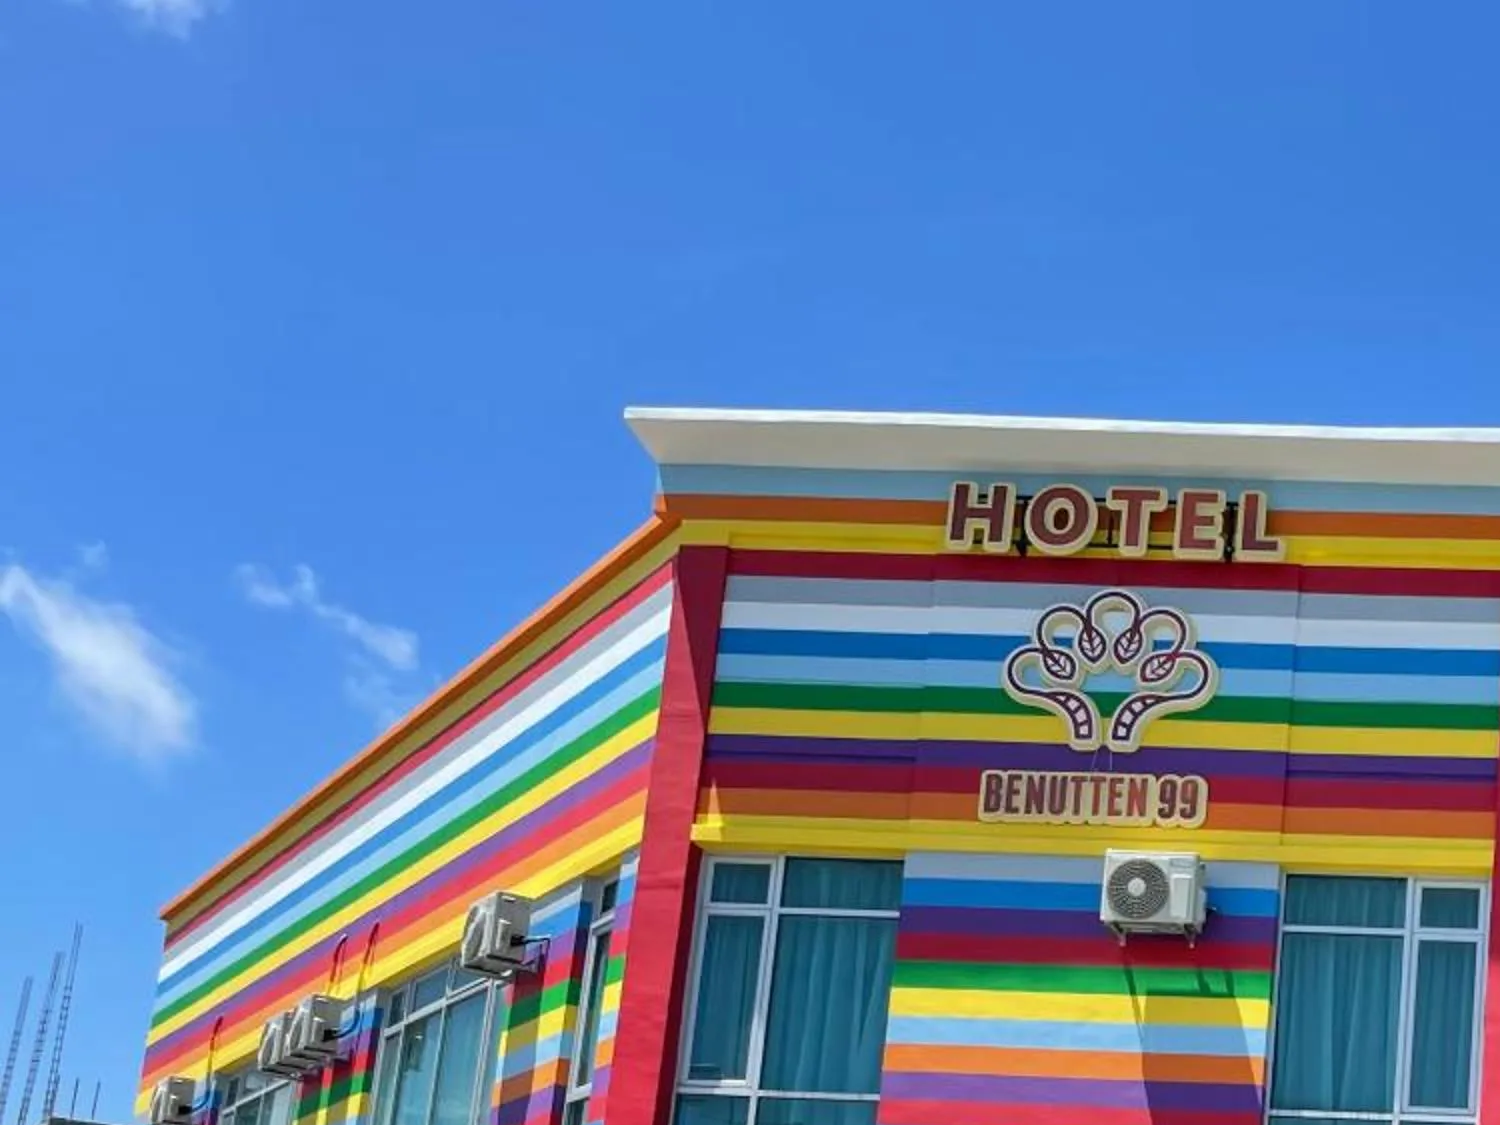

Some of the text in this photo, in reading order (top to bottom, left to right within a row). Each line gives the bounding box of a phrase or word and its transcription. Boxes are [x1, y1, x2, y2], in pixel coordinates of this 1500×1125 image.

[946, 480, 1286, 562] HOTEL
[981, 771, 1202, 821] BENUTTEN 99
